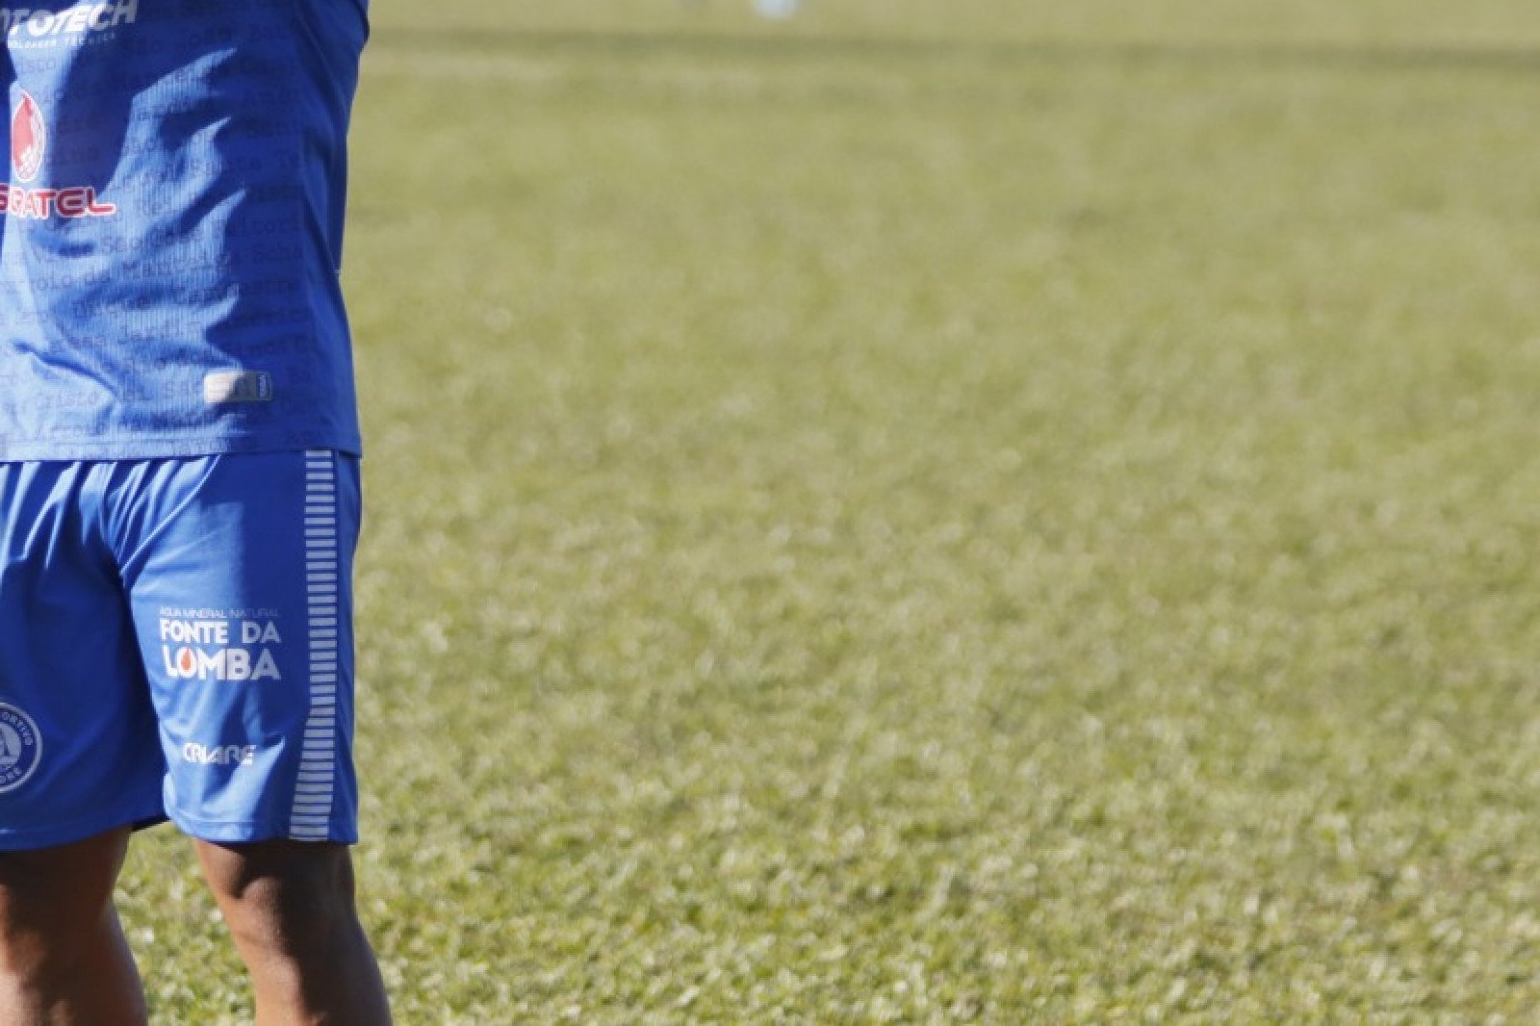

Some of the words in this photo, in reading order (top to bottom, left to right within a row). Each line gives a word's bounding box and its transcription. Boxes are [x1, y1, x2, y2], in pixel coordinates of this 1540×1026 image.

[160, 617, 229, 644] FONTE
[242, 619, 282, 644] DA
[162, 644, 282, 681] LOMBA
